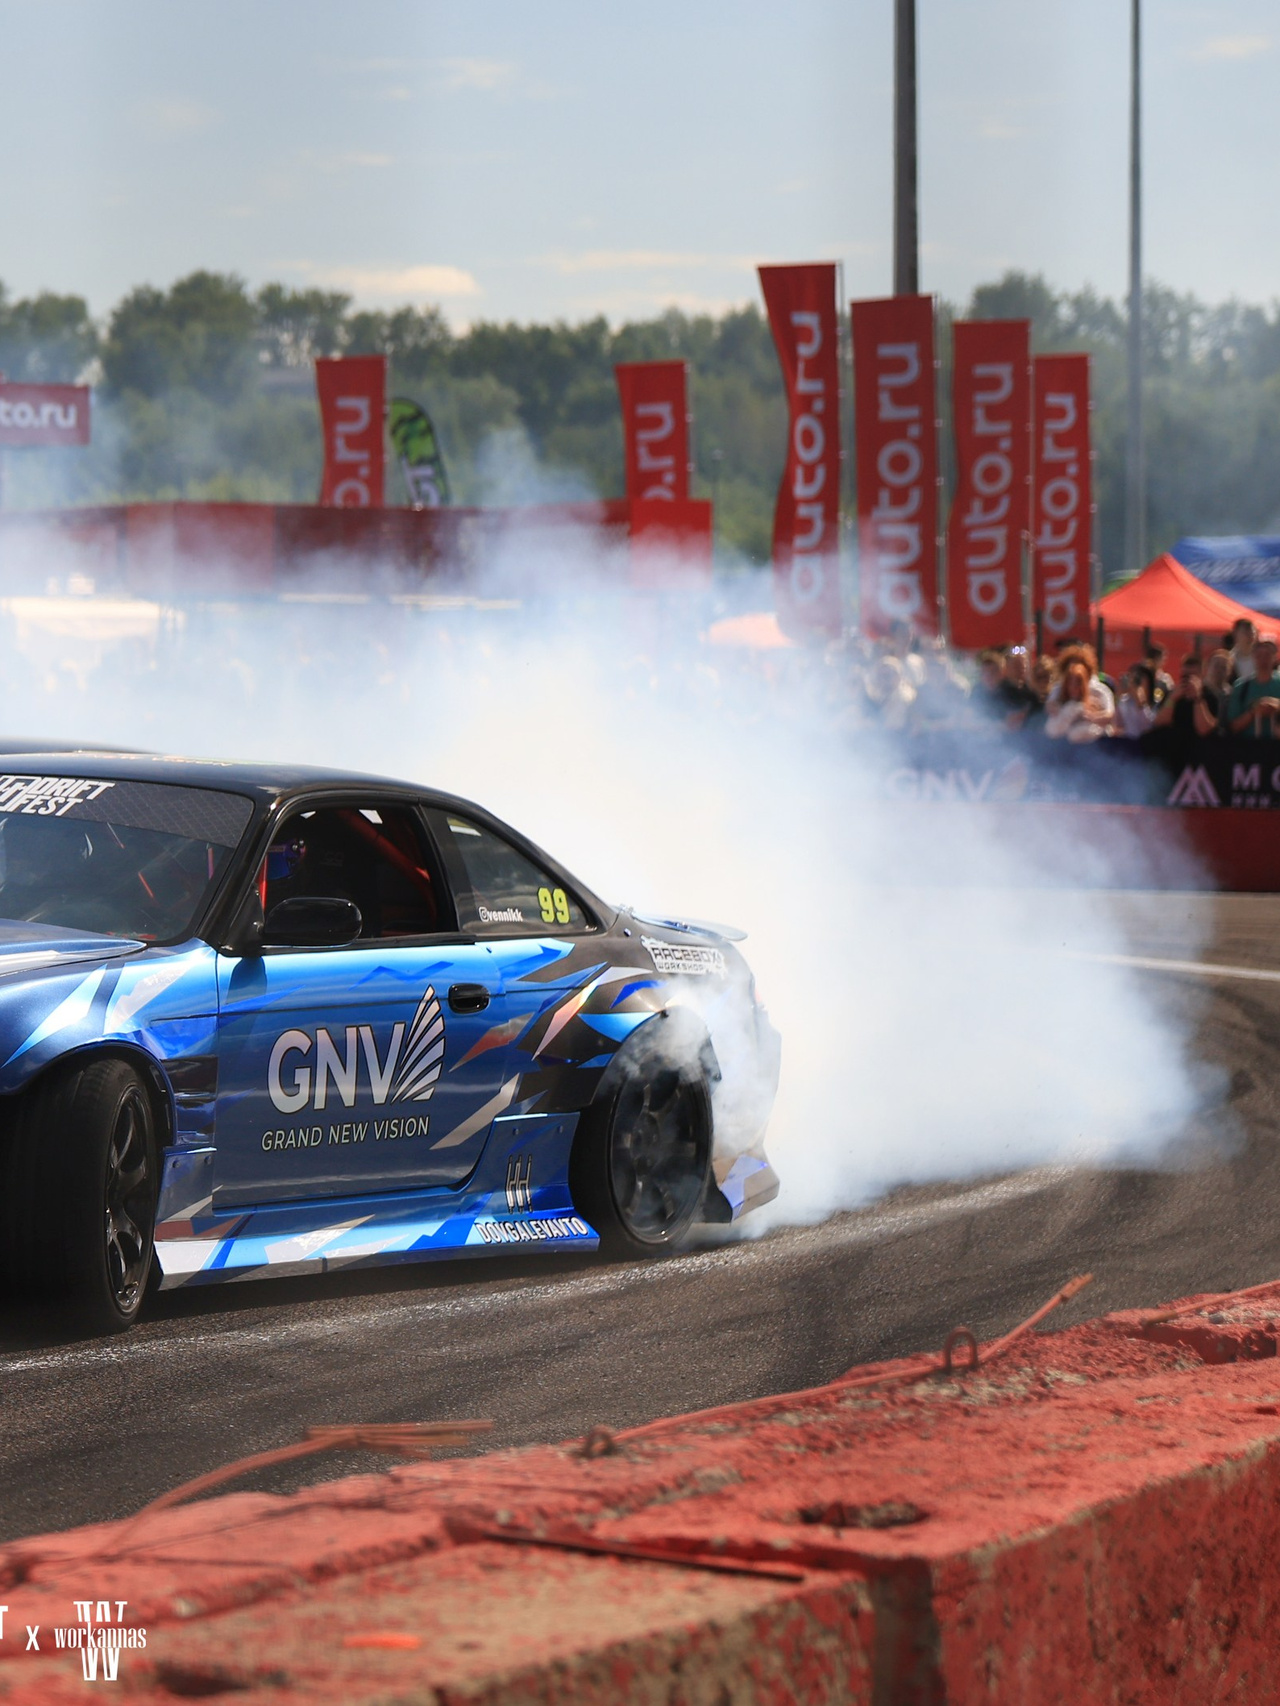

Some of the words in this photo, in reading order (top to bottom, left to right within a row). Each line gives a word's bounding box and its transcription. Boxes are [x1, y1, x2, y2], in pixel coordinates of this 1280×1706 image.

[790, 311, 826, 599] auto.ru
[872, 342, 920, 616] auto.ru
[963, 363, 1013, 614] auto.ru
[1037, 392, 1078, 633] auto.ru
[7, 794, 83, 816] FEST
[28, 777, 116, 800] DRIFT
[538, 887, 570, 924] 99
[268, 1022, 406, 1114] GNV
[261, 1126, 323, 1151] GRAND
[328, 1122, 368, 1145] NEW
[374, 1116, 430, 1142] VISION
[475, 1216, 588, 1244] DOVGALEVAVTO
